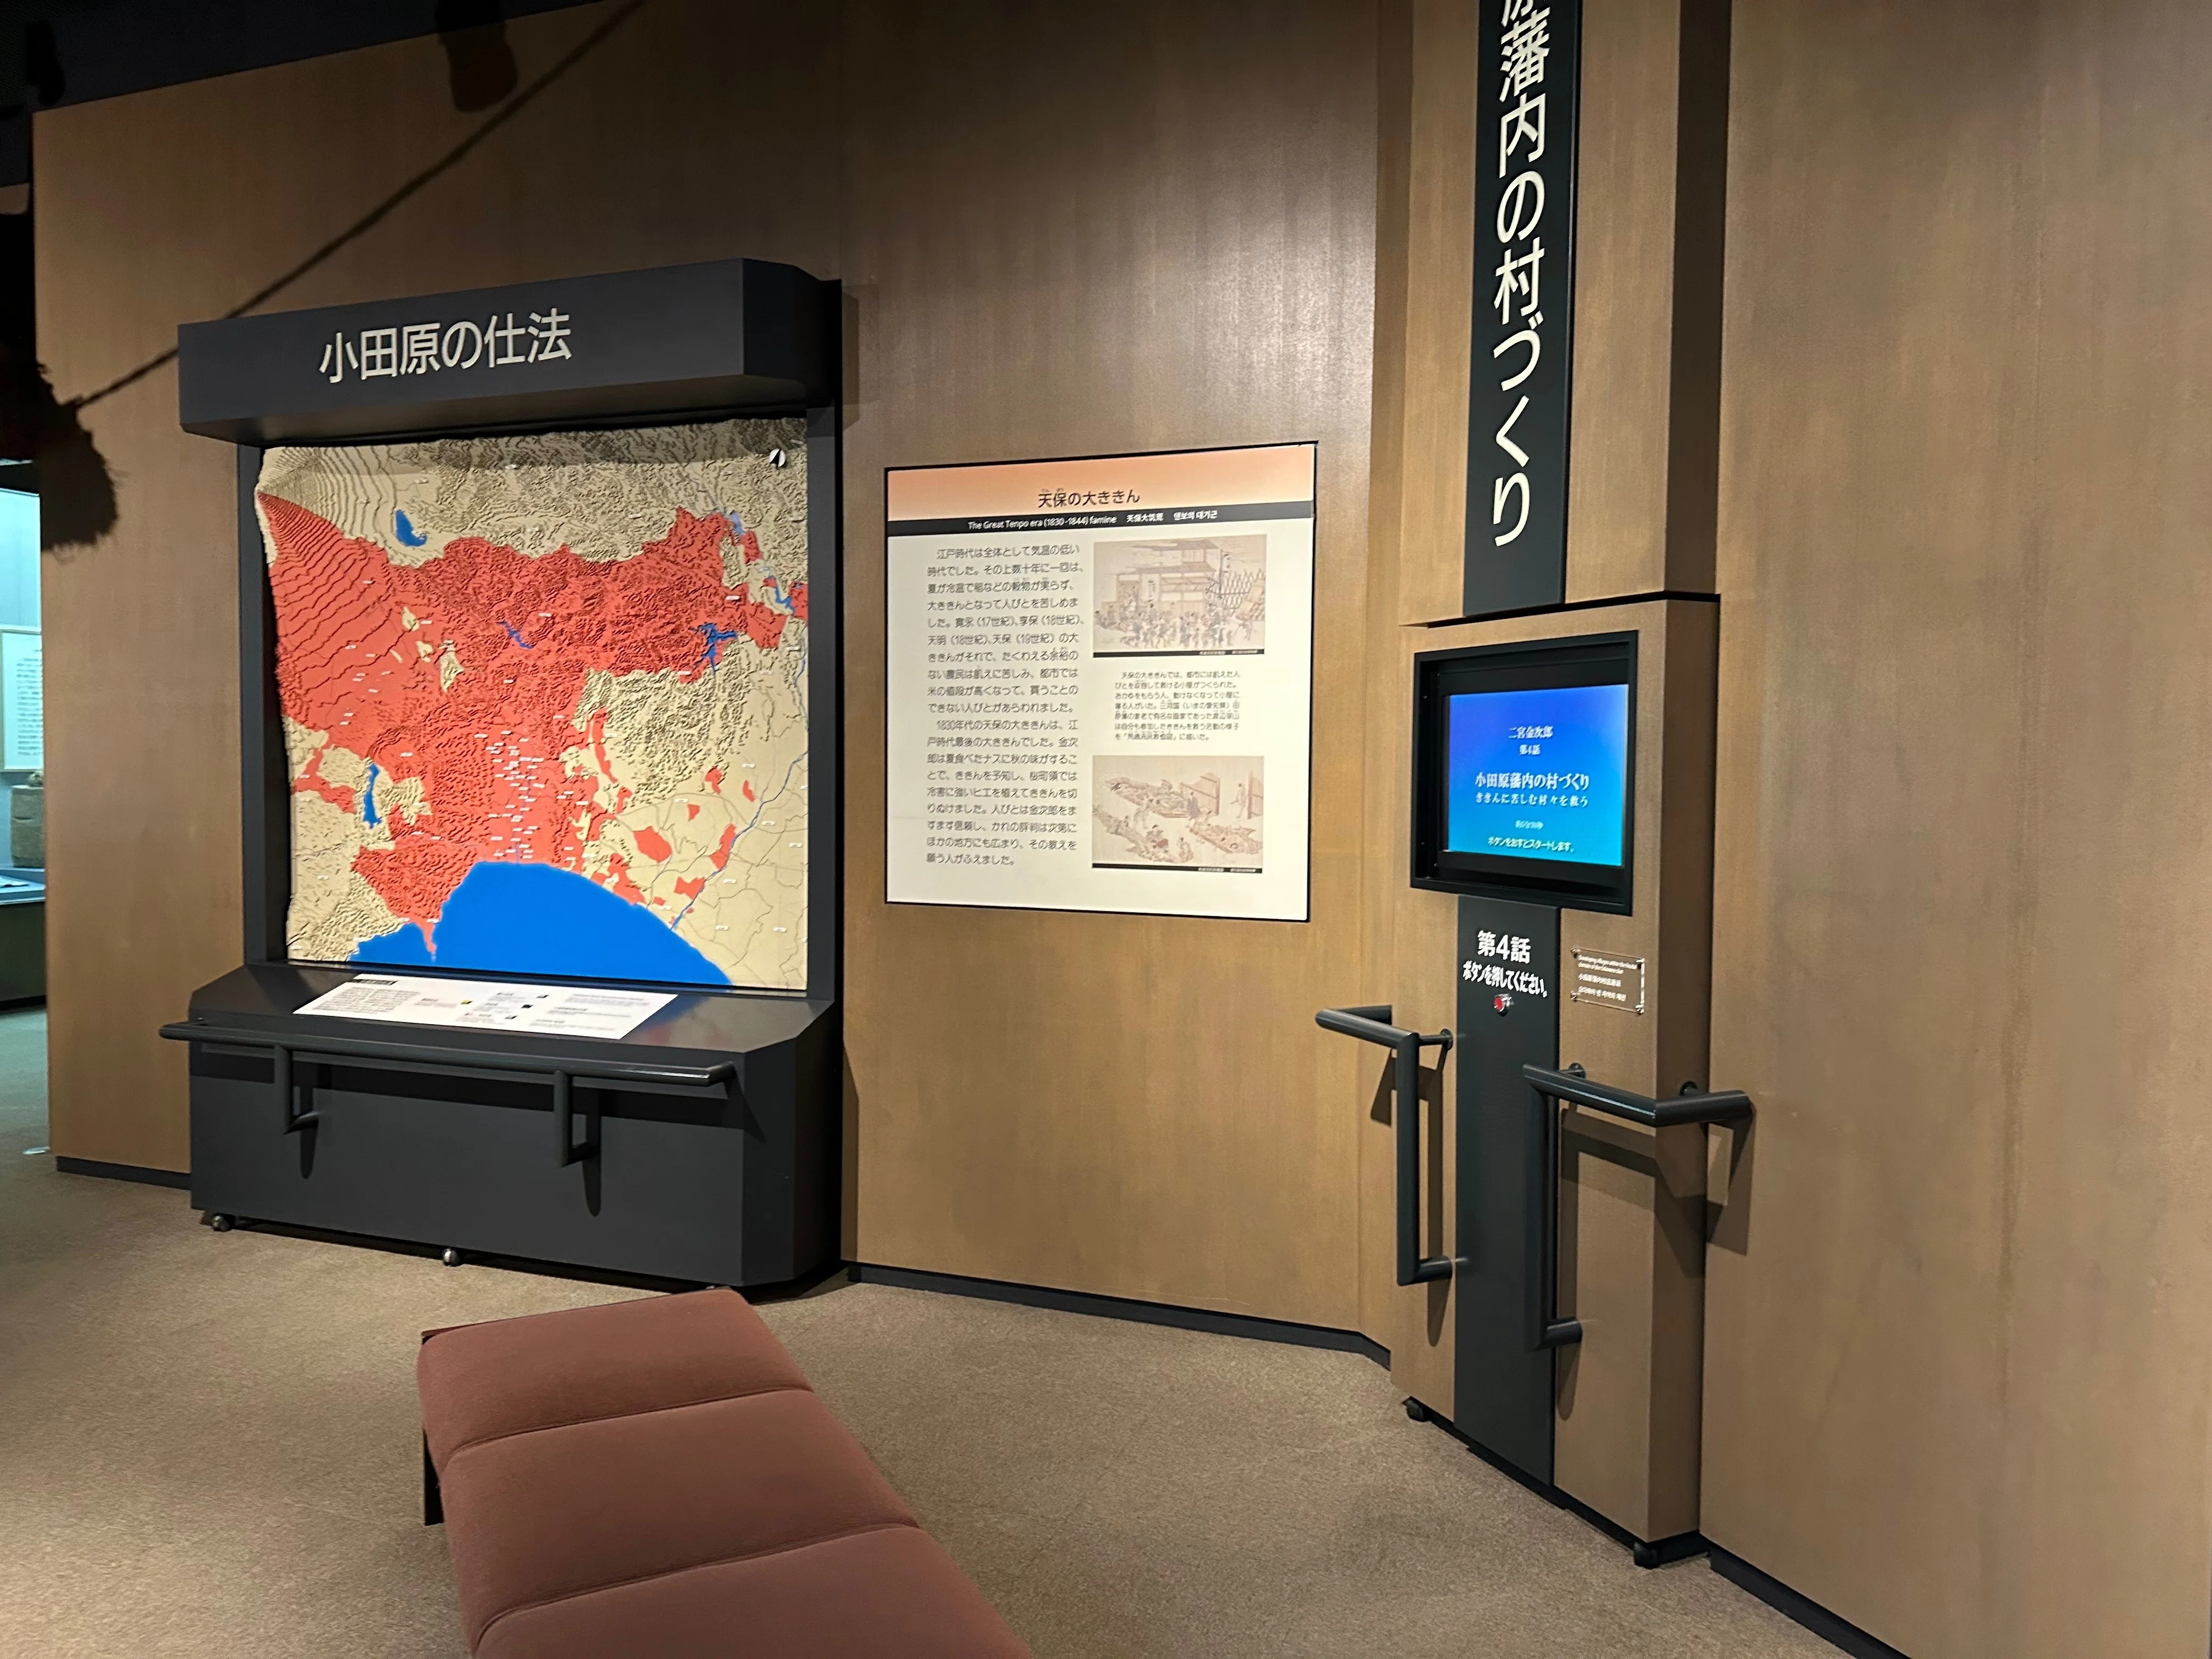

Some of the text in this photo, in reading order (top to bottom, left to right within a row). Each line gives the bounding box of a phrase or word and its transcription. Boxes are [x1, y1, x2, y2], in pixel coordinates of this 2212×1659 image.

[319, 307, 572, 383] 小田原の仕法
[1038, 489, 1140, 509] 天保の大ききん
[968, 521, 982, 529] The
[983, 521, 1005, 529] Great
[1090, 515, 1118, 524] famine
[1508, 725, 1554, 739] 二宮金次郎
[1475, 772, 1589, 790] 小田原藩内の村づくり
[1477, 929, 1531, 964] 第4話
[1462, 960, 1548, 998] ボタンを押してください。
